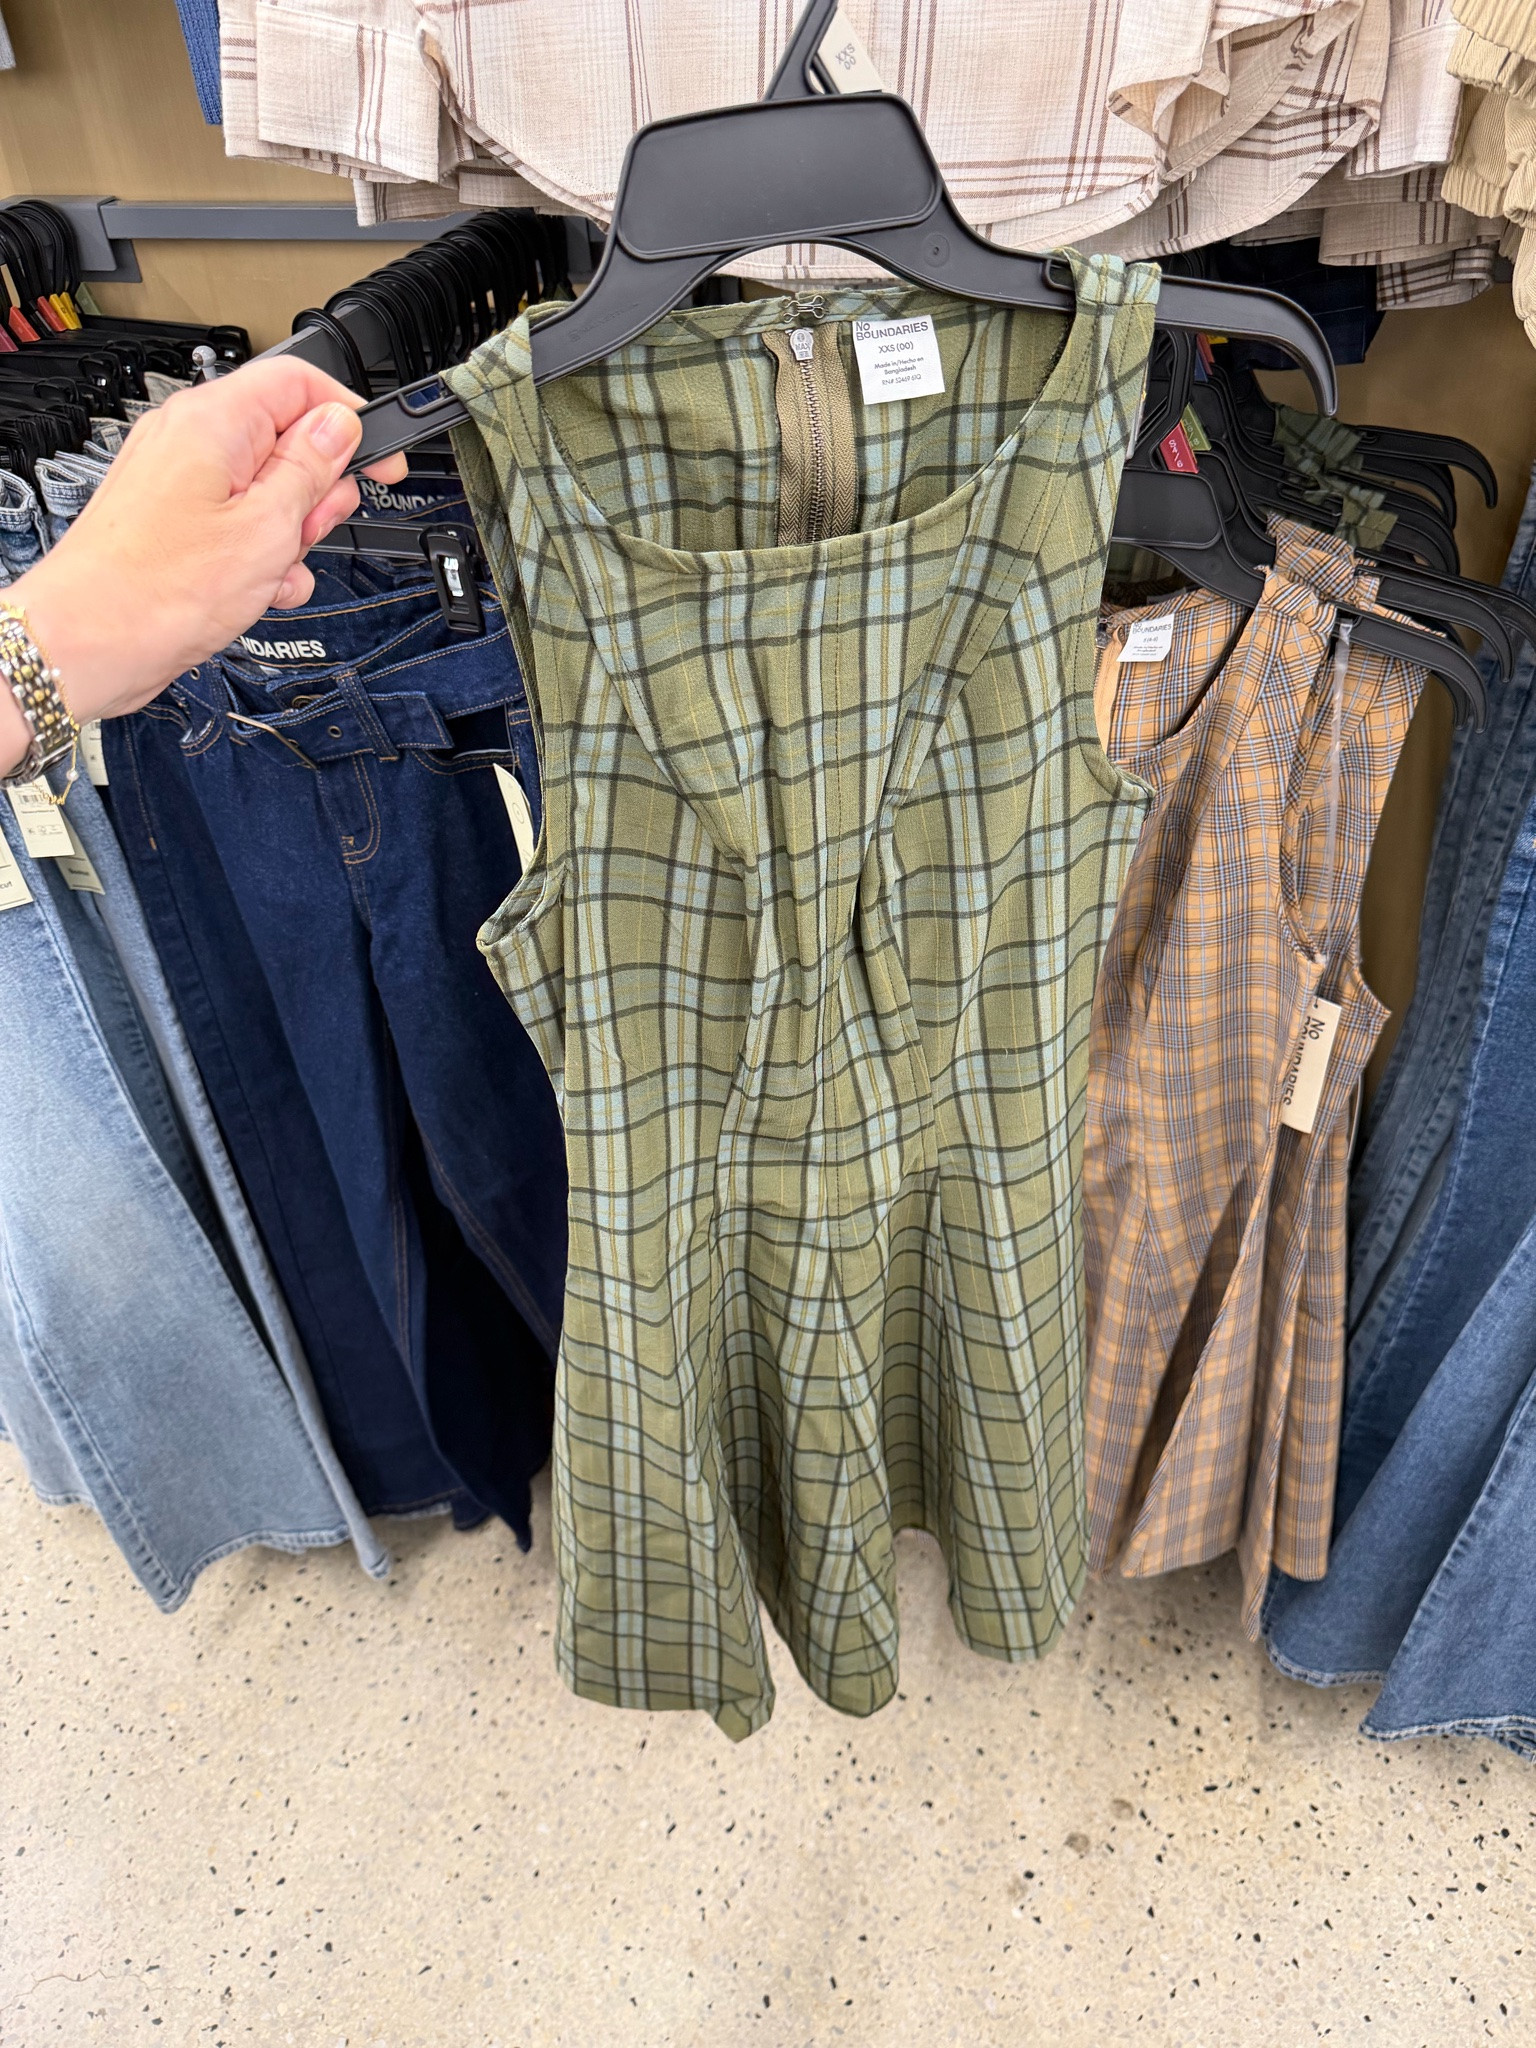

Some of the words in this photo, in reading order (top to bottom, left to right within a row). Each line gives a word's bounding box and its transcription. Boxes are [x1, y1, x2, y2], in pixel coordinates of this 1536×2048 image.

[835, 43, 855, 64] XXS
[856, 321, 929, 341] BOUNDARIES
[878, 344, 895, 354] XXS
[896, 341, 914, 353] (00)
[884, 364, 917, 375] Bangladesh
[360, 480, 389, 496] NO
[367, 493, 445, 511] BOUND
[240, 635, 327, 659] NDARIES
[1309, 1017, 1326, 1040] NO
